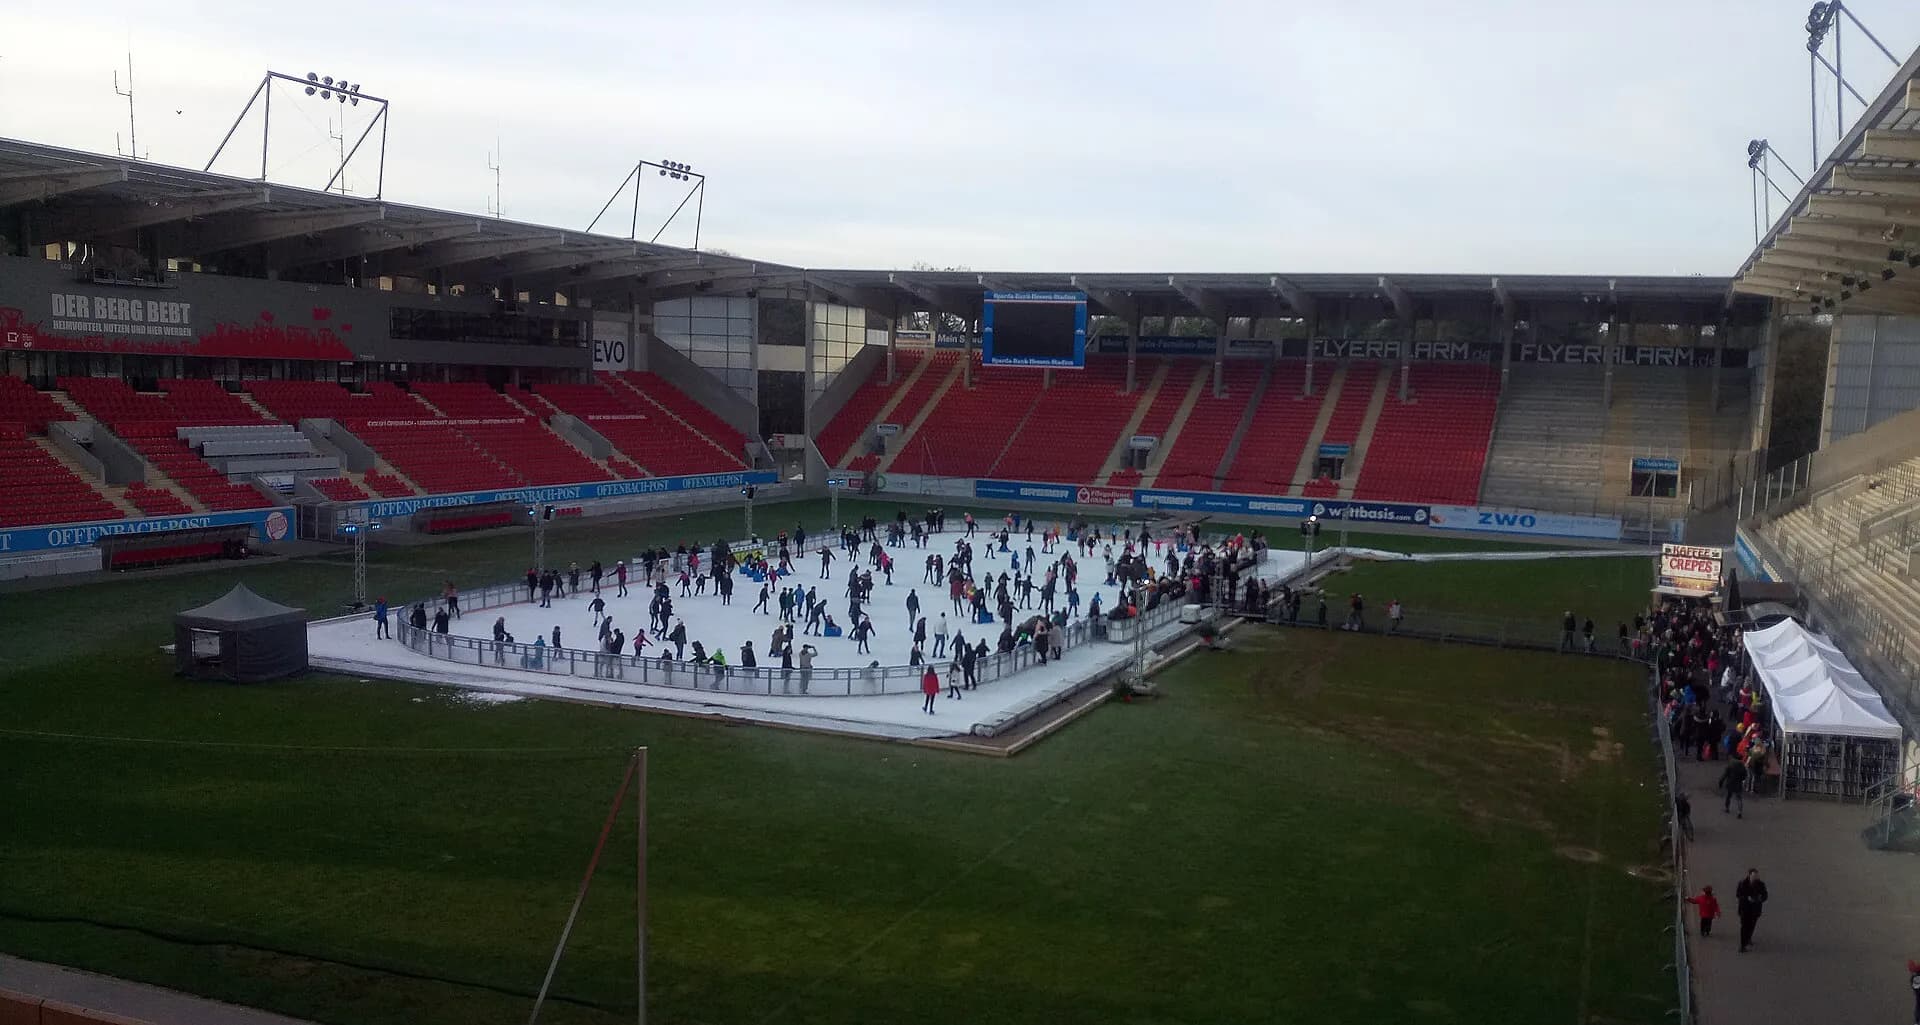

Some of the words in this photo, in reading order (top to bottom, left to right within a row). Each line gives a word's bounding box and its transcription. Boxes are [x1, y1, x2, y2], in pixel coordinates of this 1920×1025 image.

[52, 293, 89, 318] DER
[94, 296, 143, 321] BERG
[147, 300, 191, 324] BEBT
[53, 320, 102, 332] HEIMVORTEIL
[103, 322, 131, 334] NUTZEN
[131, 324, 146, 335] UND
[147, 325, 163, 335] HIER
[937, 333, 957, 343] Mein
[593, 340, 625, 363] EVO
[597, 479, 669, 496] OFFENBACH-POST
[682, 474, 744, 489] OFFENBACH-POST
[1478, 512, 1536, 528] ZWO
[1673, 546, 1711, 558] KAFFEE
[1669, 558, 1713, 573] CREPES
